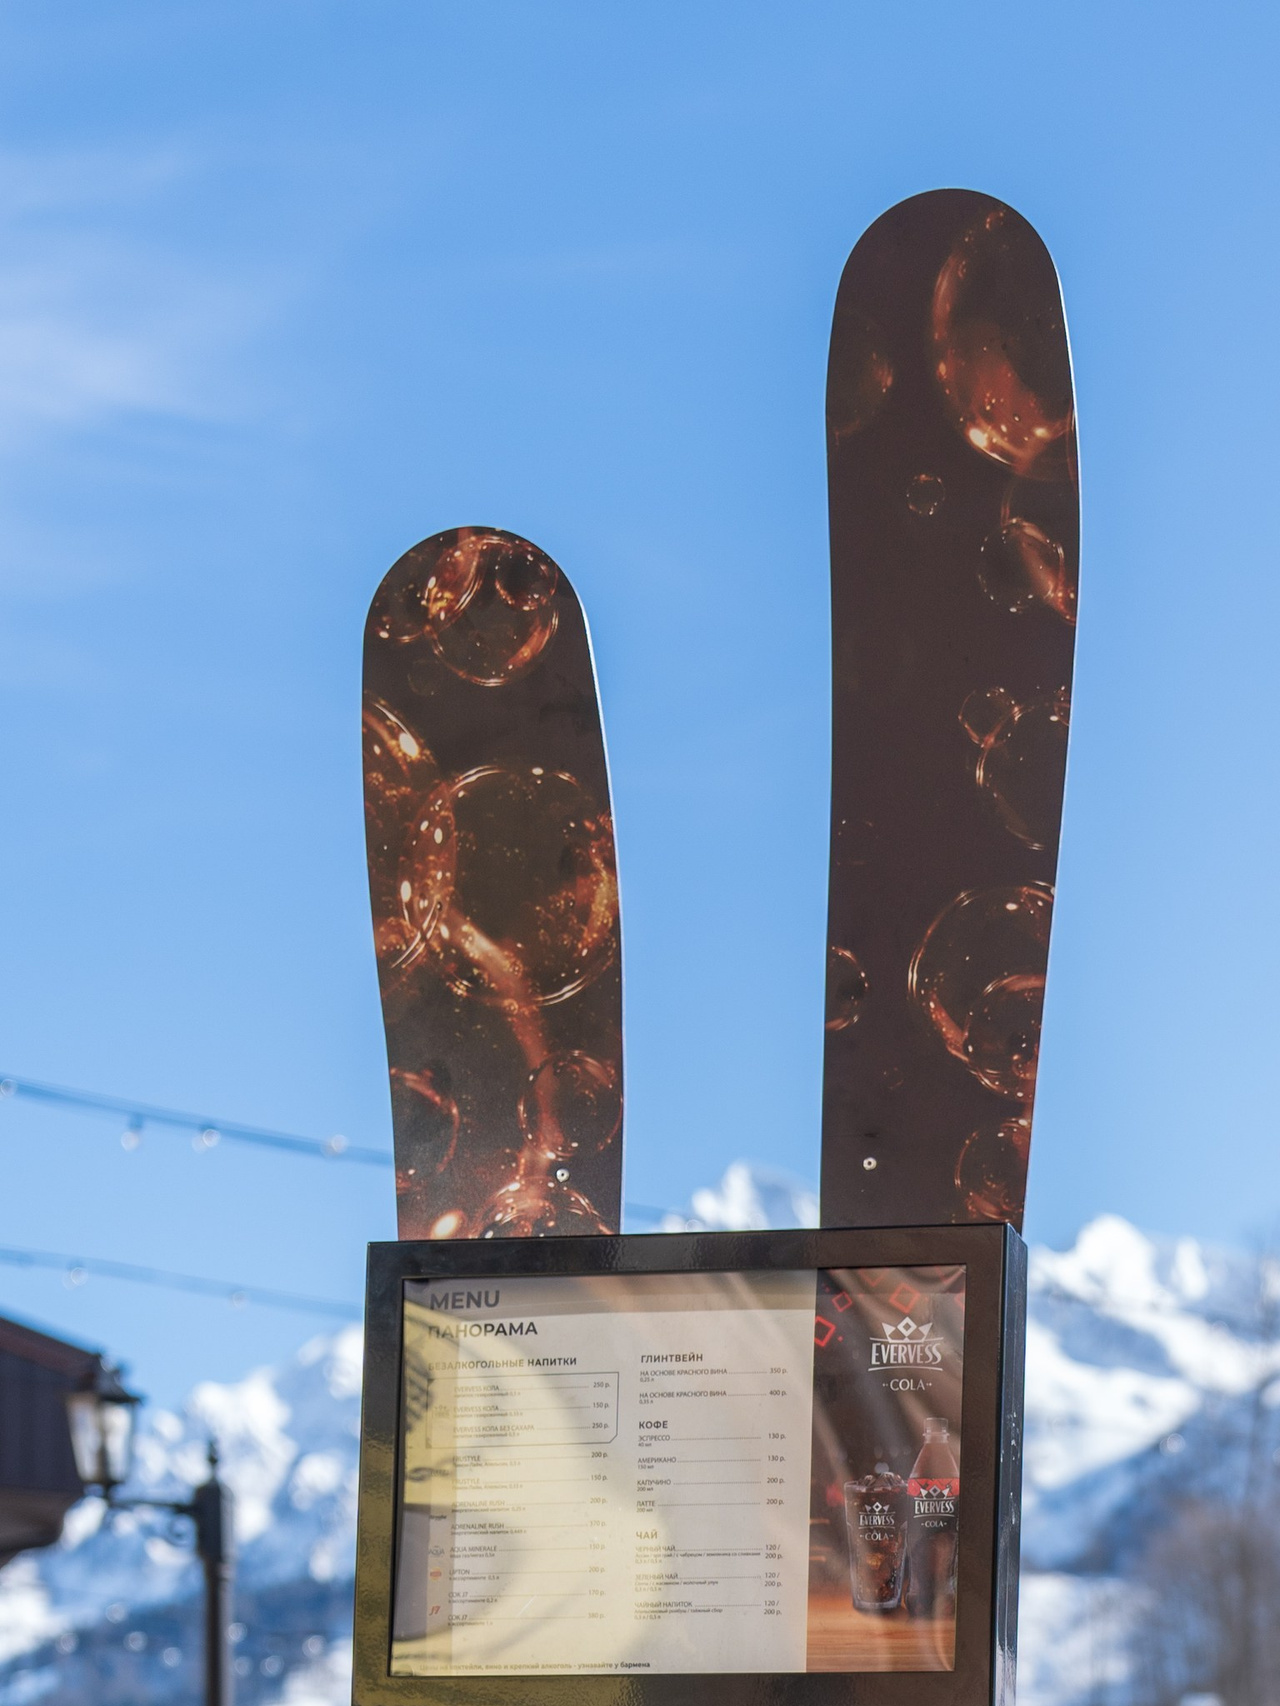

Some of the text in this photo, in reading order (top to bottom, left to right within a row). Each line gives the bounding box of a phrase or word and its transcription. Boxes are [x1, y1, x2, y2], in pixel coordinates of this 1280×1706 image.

[430, 1290, 500, 1311] MENU
[428, 1322, 538, 1339] ПАНОРАМА
[641, 1353, 703, 1363] ГЛИНТВЕЙН
[871, 1343, 943, 1366] EVERVESS
[428, 1357, 577, 1371] БЕЗАЛКОГОЛЬНЫЕ НАПИТКИ
[890, 1378, 925, 1391] COLA
[639, 1420, 668, 1430] КОФЕ
[915, 1499, 955, 1514] EVERVESS
[859, 1514, 895, 1527] EVERVESS
[924, 1520, 944, 1529] COLA
[636, 1529, 658, 1540] ЧАЙ
[865, 1530, 889, 1542] COLA
[429, 1605, 441, 1616] J7
[621, 1661, 651, 1669] бармена
